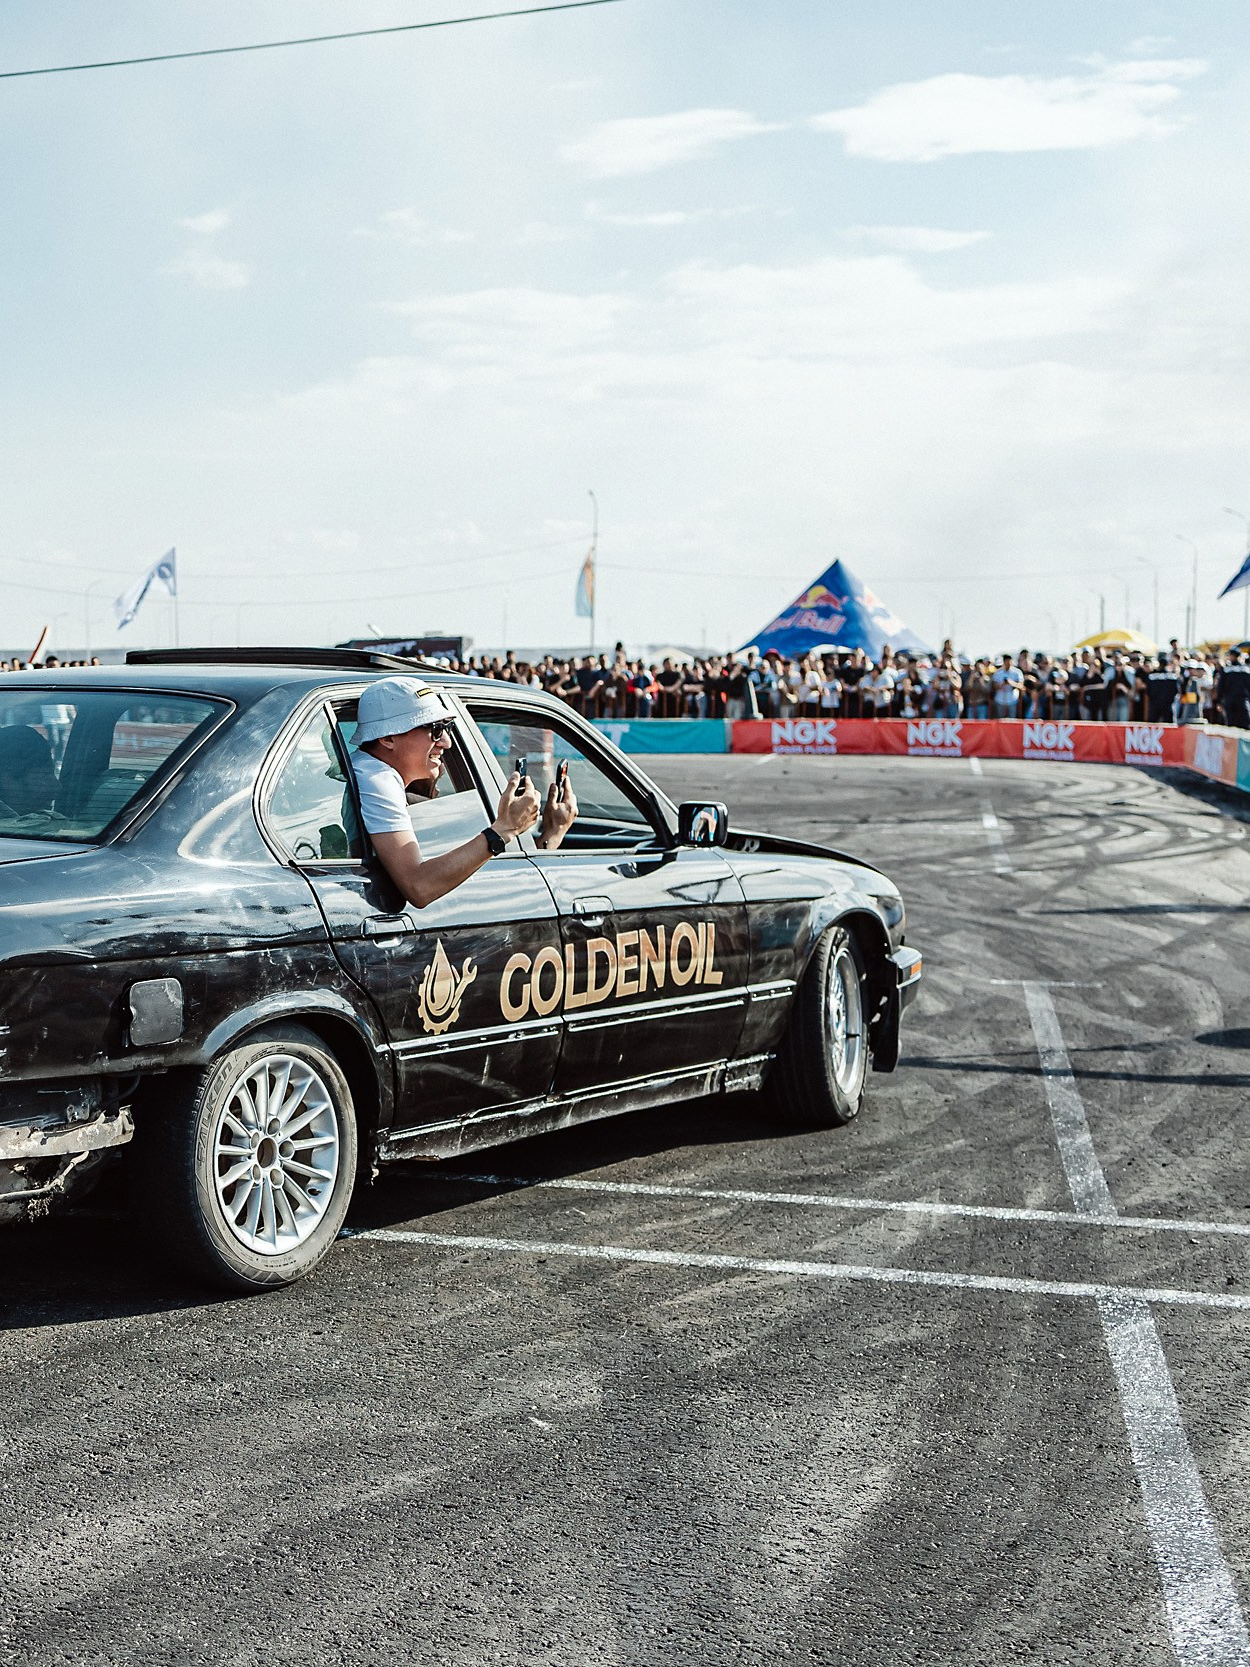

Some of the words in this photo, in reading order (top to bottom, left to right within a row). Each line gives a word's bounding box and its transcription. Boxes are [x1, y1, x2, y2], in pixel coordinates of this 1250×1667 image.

[772, 720, 837, 744] NGK
[908, 721, 962, 746] NGK
[1023, 723, 1075, 749] NGK
[1125, 727, 1163, 754] NGK
[500, 924, 664, 1022] GOLDEN
[670, 921, 723, 986] OIL
